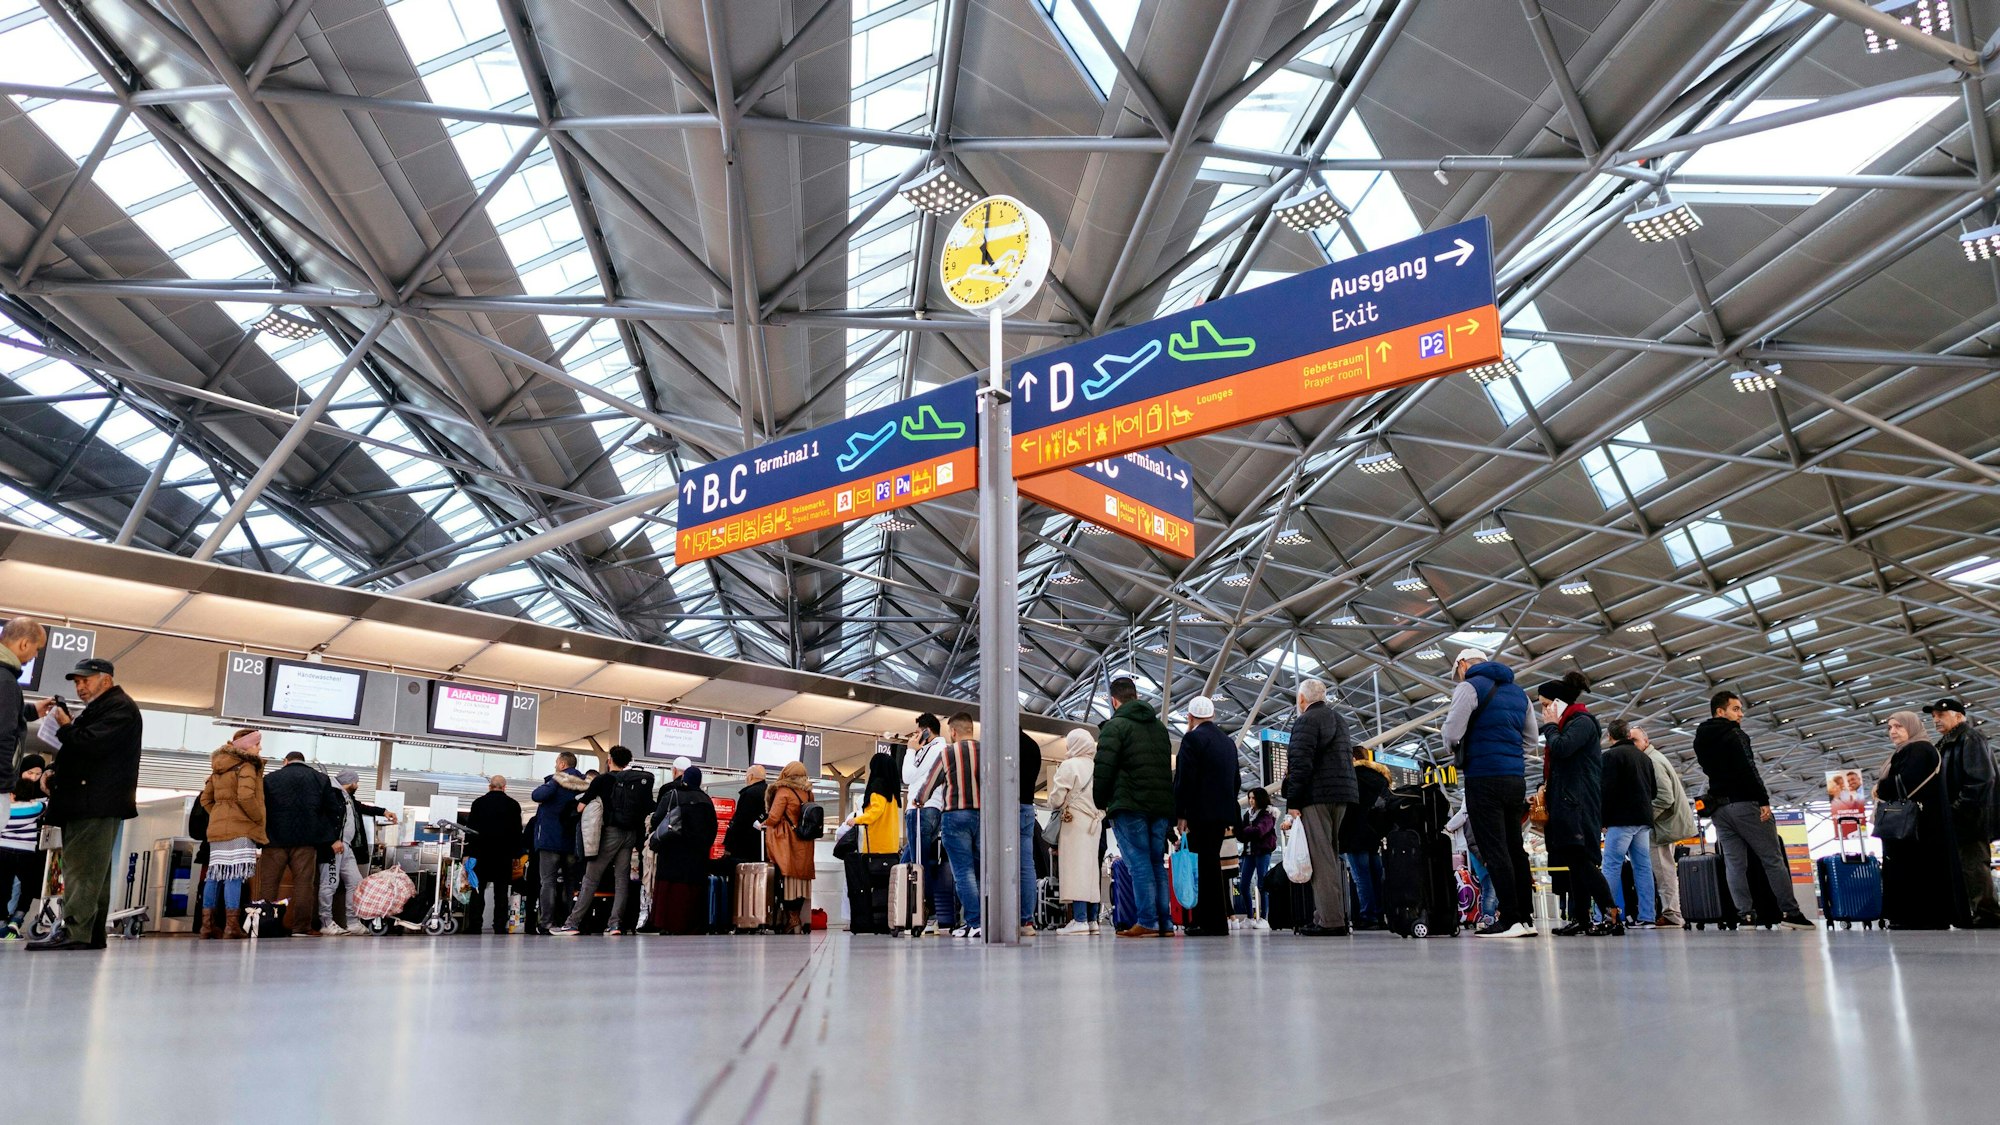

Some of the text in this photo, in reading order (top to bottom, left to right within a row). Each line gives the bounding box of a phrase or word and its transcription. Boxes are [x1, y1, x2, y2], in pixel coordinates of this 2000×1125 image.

[1330, 256, 1428, 300] Ausgang
[1332, 301, 1379, 333] Exit
[1303, 354, 1364, 377] Gebetsraum
[1304, 367, 1363, 390] Prayer room
[1050, 362, 1074, 412] D
[1196, 388, 1233, 405] Lounges
[1051, 430, 1063, 441] WC
[1075, 426, 1088, 437] WC
[702, 440, 819, 514] B.C Terminal 1
[1166, 465, 1172, 481] 1
[792, 500, 826, 515] Reisemarkt
[791, 508, 830, 525] Travel market
[51, 632, 88, 652] D29
[233, 657, 264, 675] D28
[451, 689, 496, 703] AirArabia
[513, 695, 535, 710] D27
[624, 710, 644, 724] D26
[663, 718, 697, 730] AirArabia
[764, 730, 795, 742] AirArabia
[805, 734, 820, 747] D25
[878, 744, 891, 756] D24
